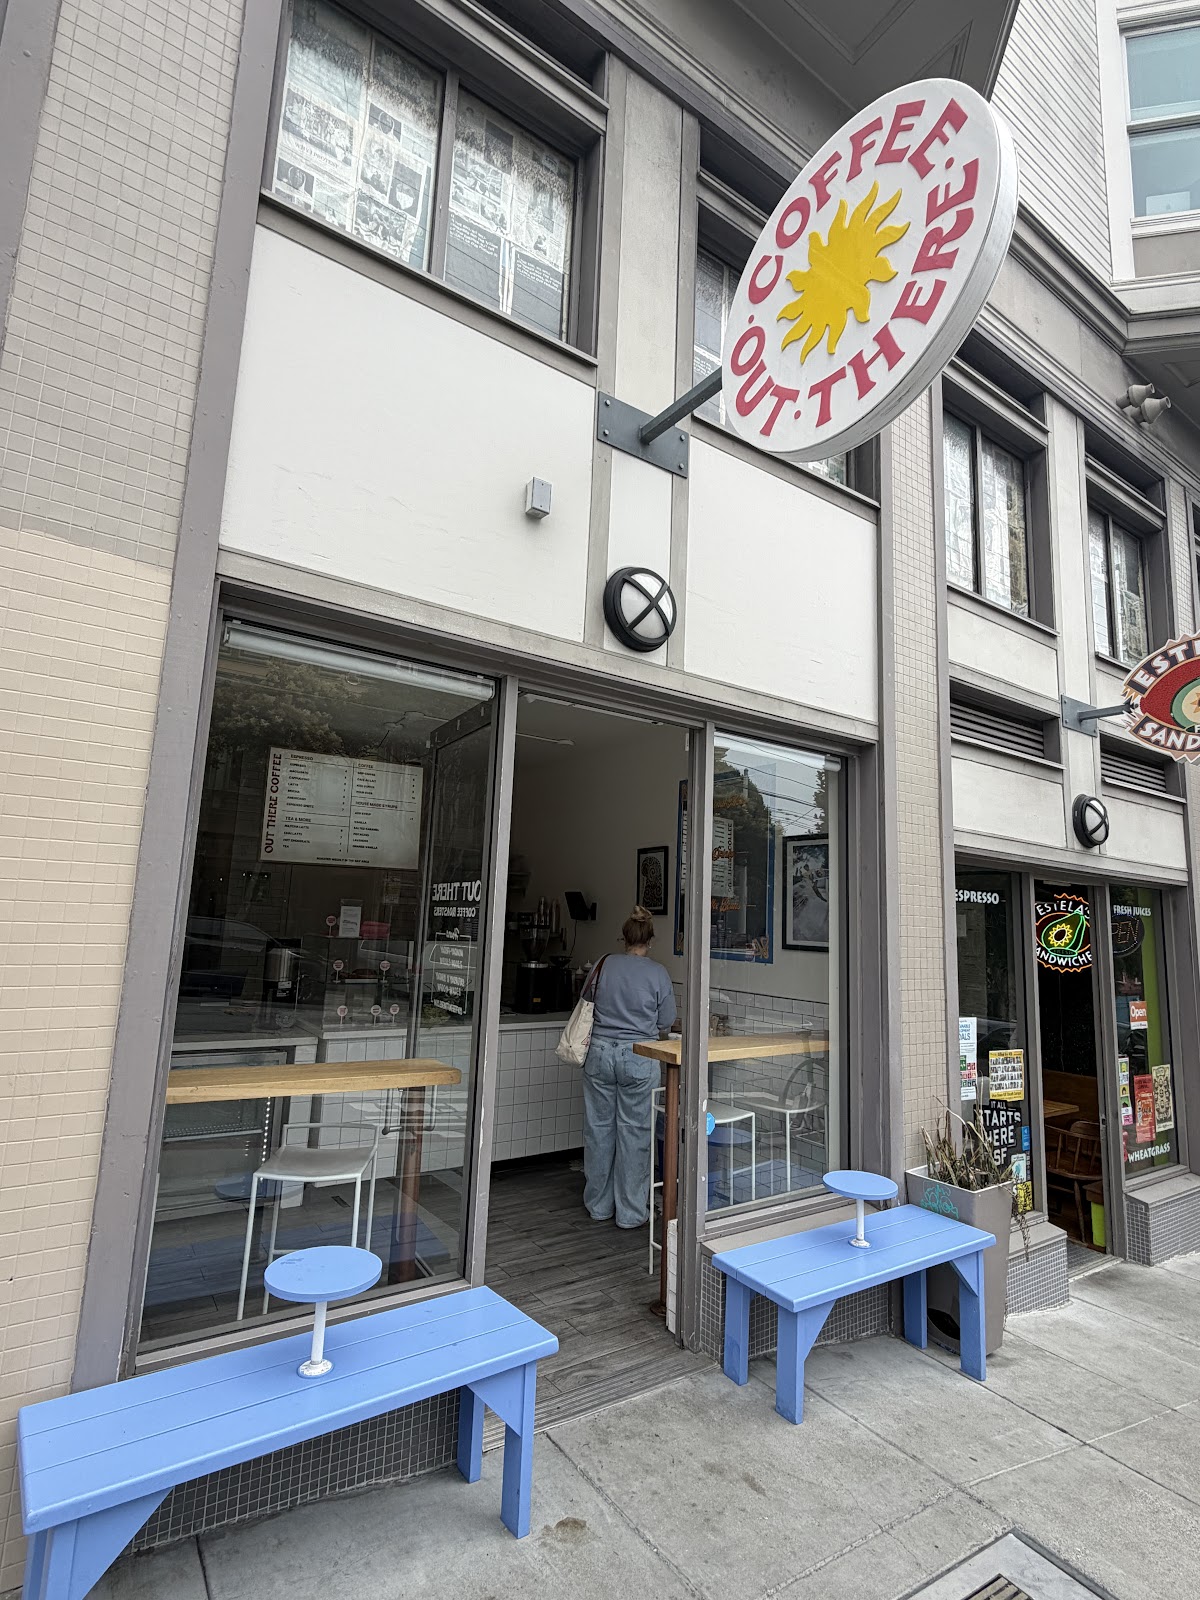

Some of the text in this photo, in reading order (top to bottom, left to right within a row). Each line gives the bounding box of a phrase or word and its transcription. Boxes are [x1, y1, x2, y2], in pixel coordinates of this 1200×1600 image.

[748, 97, 969, 305] COFFEE
[730, 157, 979, 437] OUT THERE
[265, 753, 282, 854] OUT THERE COFFEE
[955, 888, 1000, 904] ESPRESSO
[1113, 904, 1152, 916] FRESH JUICES
[1111, 919, 1140, 944] PEN
[1036, 947, 1092, 967] ANDWICHE
[1130, 1005, 1147, 1020] Open
[991, 1100, 1007, 1109] IT ALL
[993, 1147, 1008, 1166] SF
[1128, 1142, 1171, 1163] WHEATGRASS
